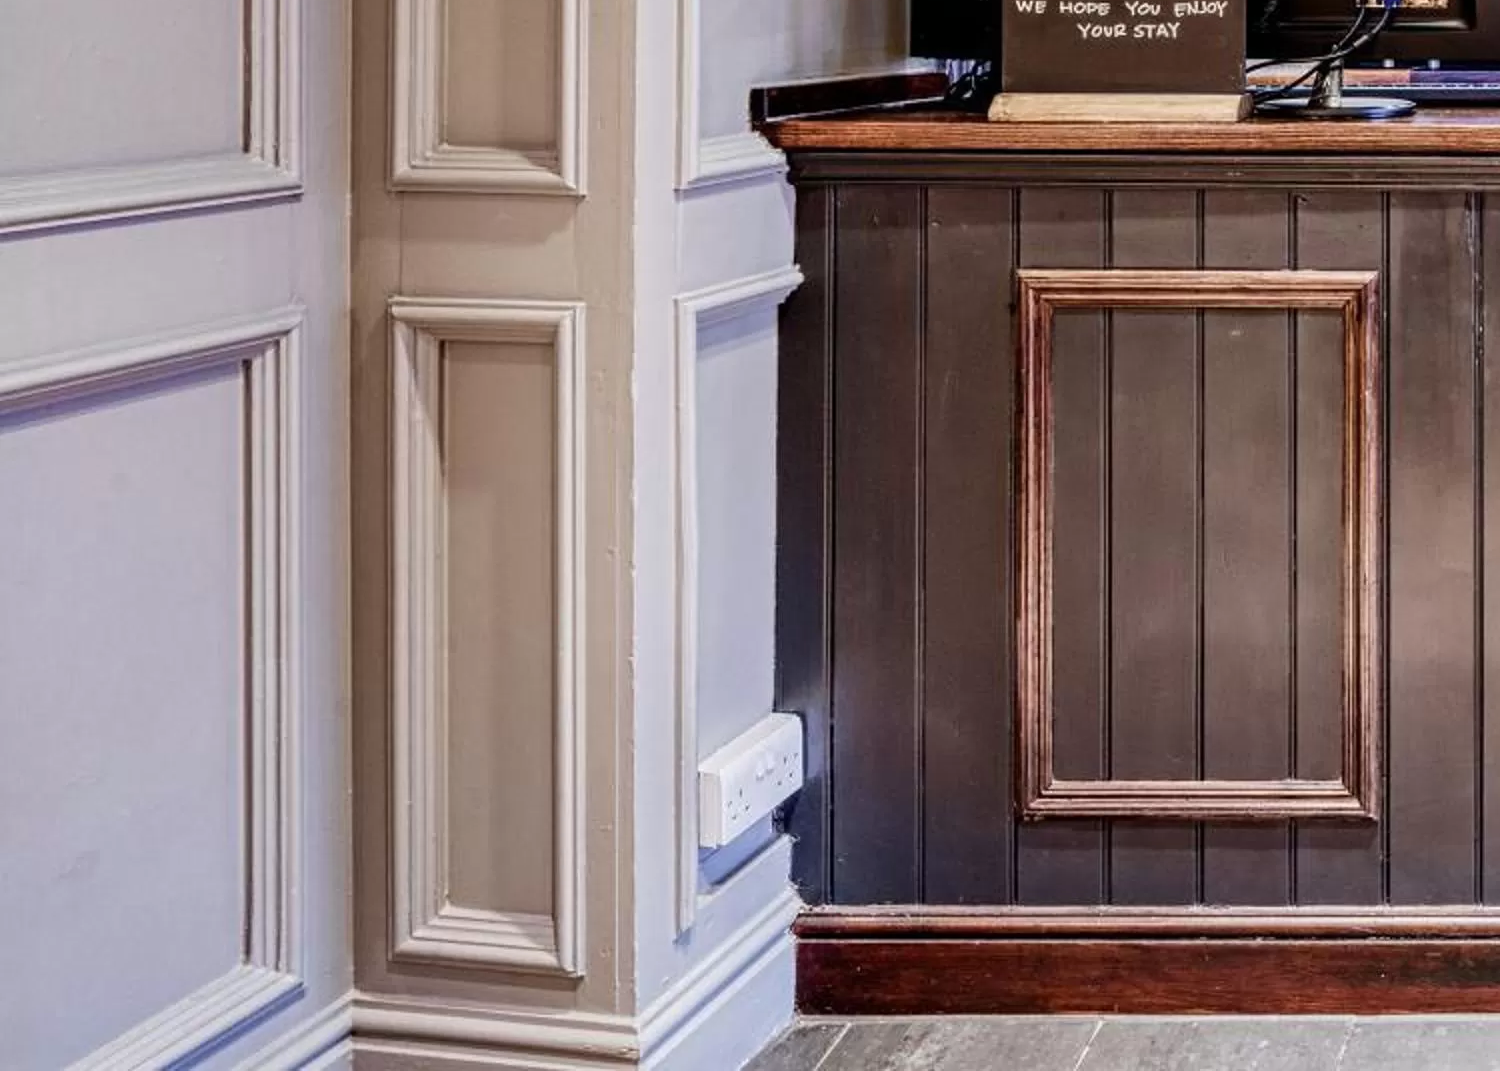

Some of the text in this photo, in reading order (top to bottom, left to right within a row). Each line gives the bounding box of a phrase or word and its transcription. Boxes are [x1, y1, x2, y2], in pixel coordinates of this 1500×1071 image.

[1016, 0, 1229, 18] WE HOPE YOU ENJOY
[1077, 22, 1181, 39] YOUR STAY
